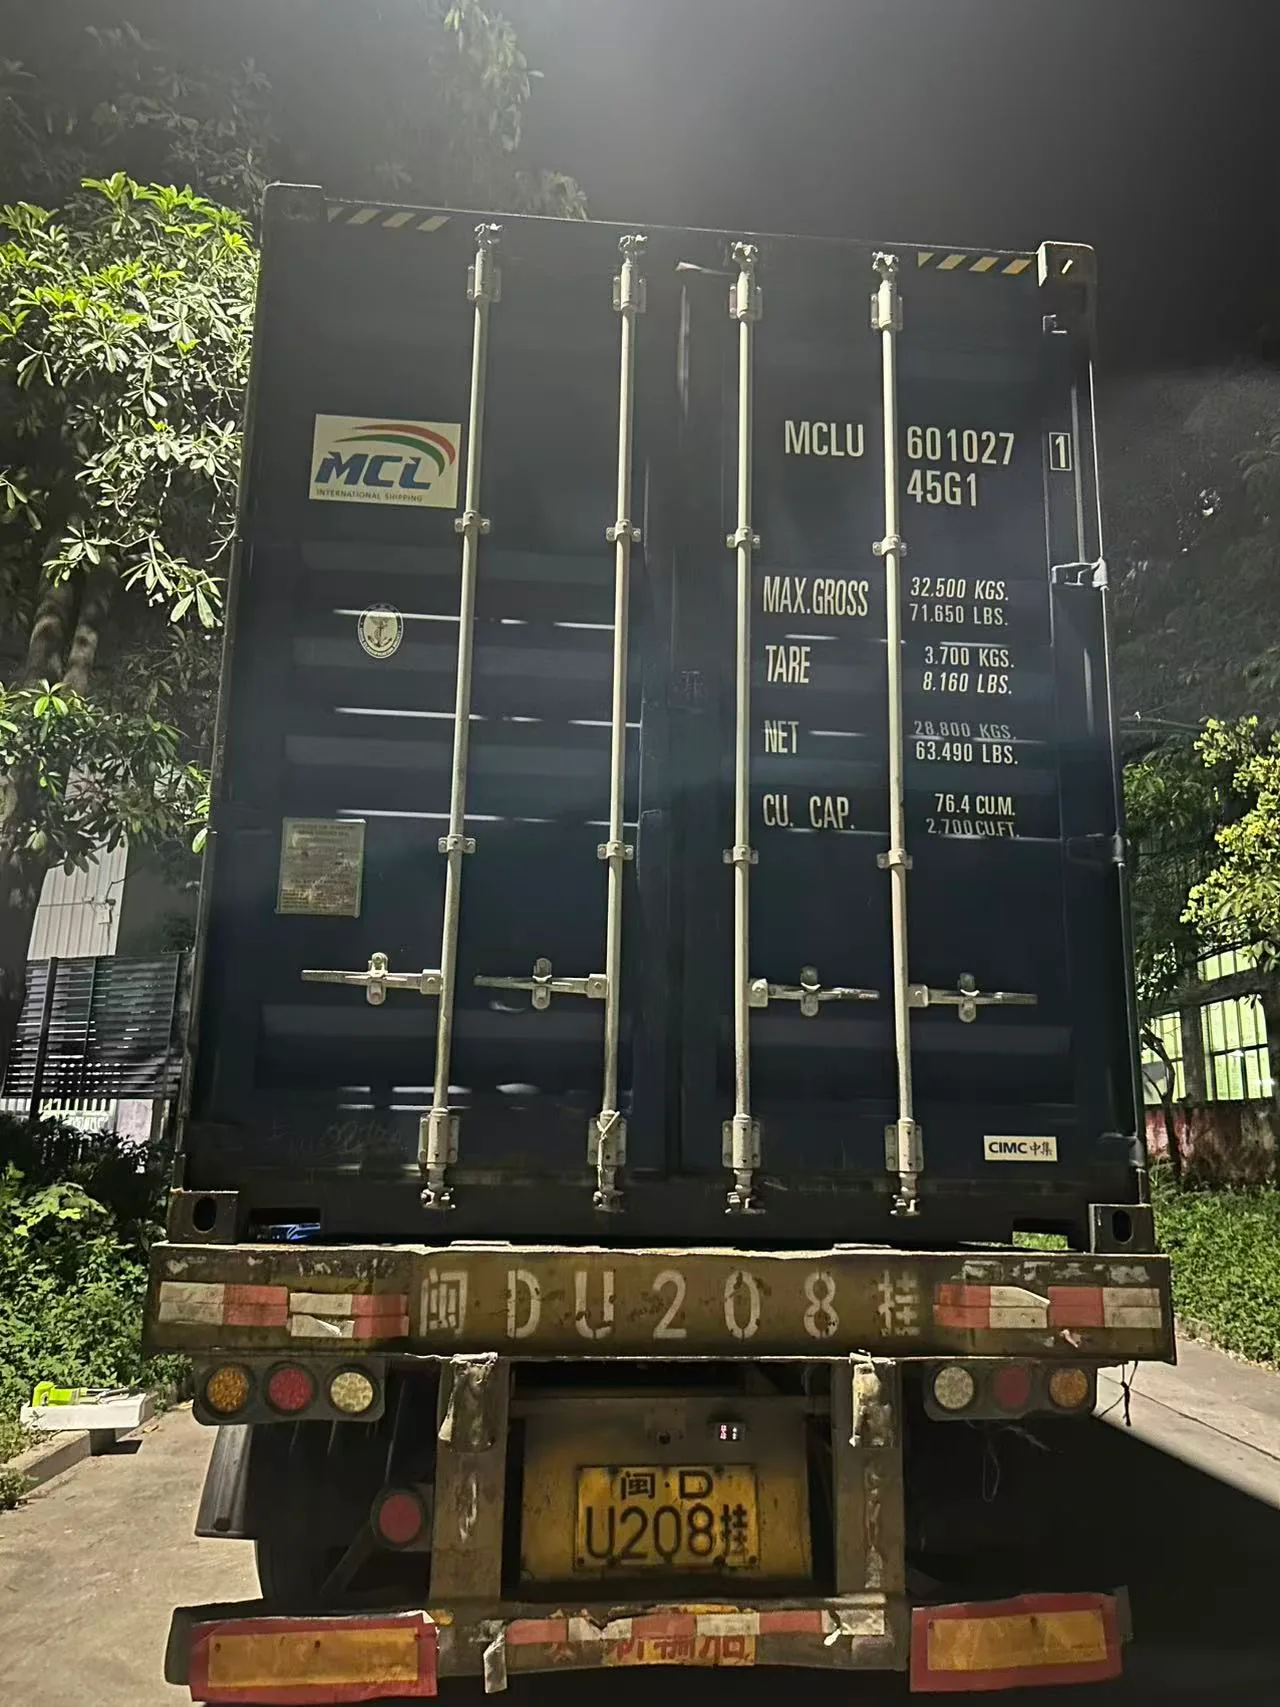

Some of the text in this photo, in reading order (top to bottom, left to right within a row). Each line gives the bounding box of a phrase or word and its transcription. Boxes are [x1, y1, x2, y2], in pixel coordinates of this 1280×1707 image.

[784, 420, 1067, 469] MCLU 601027 1
[314, 451, 432, 490] MCL
[316, 488, 423, 503] INTERNATIONAL SHIPPING
[907, 469, 978, 507] 45G1
[762, 575, 869, 617] MAX.GROSS
[974, 579, 1009, 601] KGS.
[909, 603, 1008, 626] 71.650 LBS.
[765, 645, 811, 683] TARE
[924, 646, 1015, 668] 3.700 KGS.
[922, 671, 1012, 694] 8.160 LBS.
[763, 720, 799, 754] NET
[916, 741, 1018, 765] 63.490 LBS.
[762, 793, 855, 830] CU. CAP.
[934, 793, 970, 814] 76.4
[988, 1141, 1028, 1154] CIMC
[585, 1503, 748, 1560] U208挂
